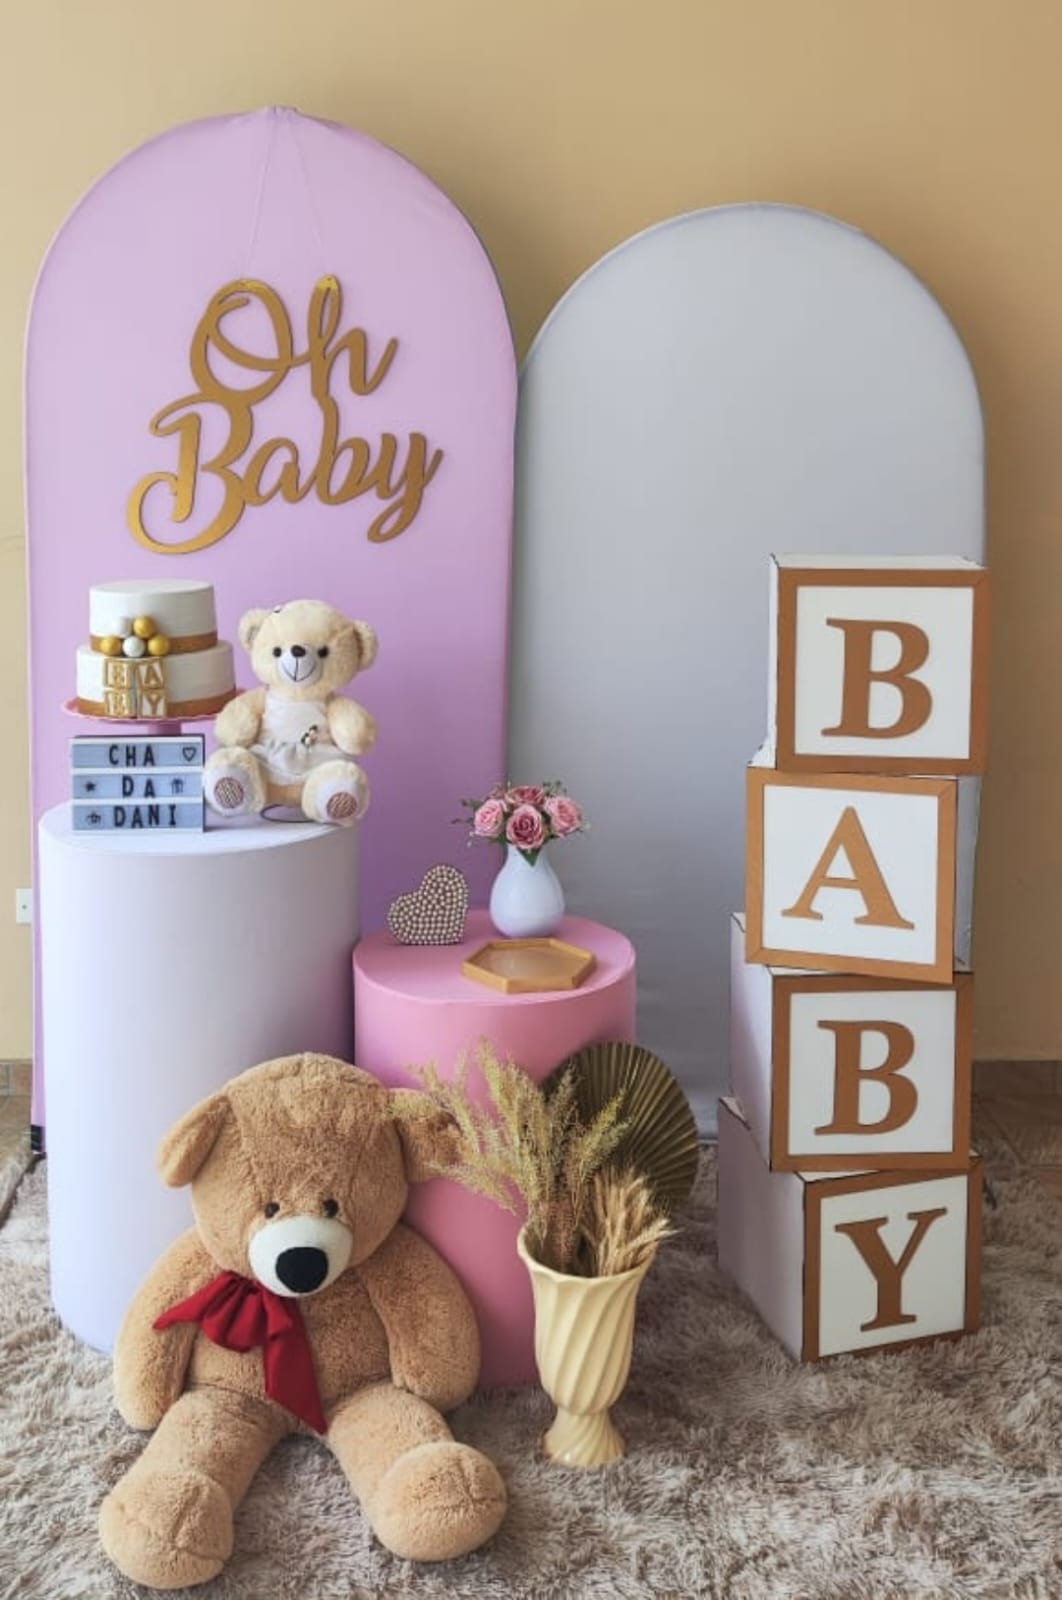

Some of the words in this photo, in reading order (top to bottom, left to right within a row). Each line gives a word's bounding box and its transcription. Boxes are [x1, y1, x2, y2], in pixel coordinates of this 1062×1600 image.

[190, 274, 398, 404] Oh
[127, 393, 444, 555] Baby
[110, 745, 156, 766] CHA
[122, 776, 156, 797] DA
[115, 805, 177, 828] DANI
